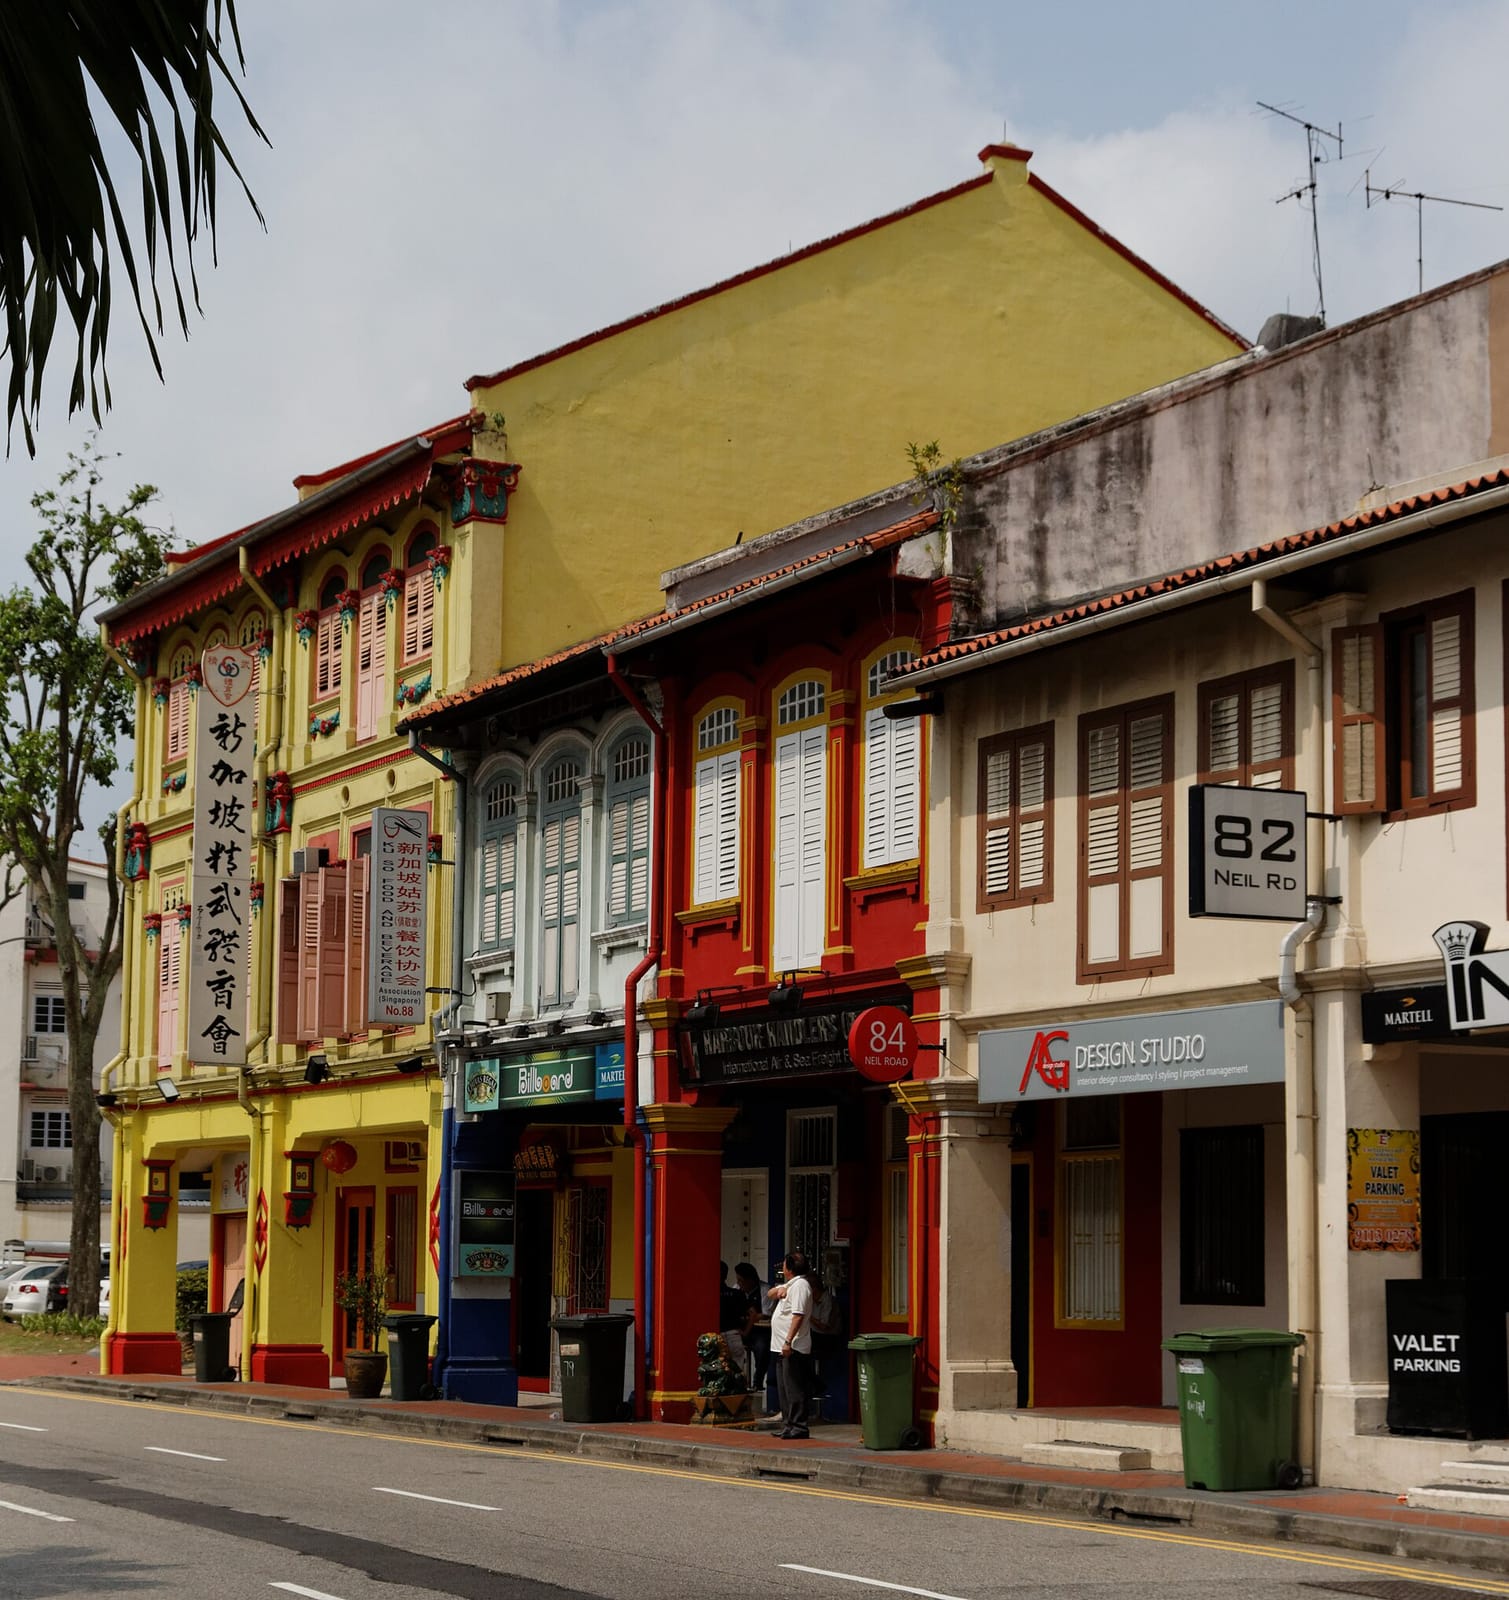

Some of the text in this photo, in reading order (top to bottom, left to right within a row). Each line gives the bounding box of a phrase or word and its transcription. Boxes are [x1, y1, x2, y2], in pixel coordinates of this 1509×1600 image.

[1214, 814, 1297, 863] 82
[381, 877, 394, 903] FOOD
[381, 908, 394, 928] AND
[380, 933, 393, 984] BEVERAGE
[378, 986, 422, 997] Association
[378, 995, 421, 1006] (Singapore)
[385, 1004, 414, 1017] No.88
[1384, 1009, 1435, 1026] MARTELL
[869, 1020, 907, 1053] 84
[1075, 1034, 1206, 1069] DESIGN STUDIO
[864, 1056, 883, 1066] NEIL
[884, 1056, 909, 1067] ROAD
[518, 1063, 574, 1095] Billboard
[601, 1070, 626, 1083] MARTEL
[1077, 1064, 1249, 1086] interior design consultancy styling project management
[296, 1171, 307, 1181] 90
[1370, 1165, 1399, 1179] VALET
[1365, 1182, 1405, 1196] PARKING
[463, 1201, 514, 1217] Billboard
[1392, 1334, 1460, 1352] VALET
[1393, 1358, 1461, 1373] PARKING
